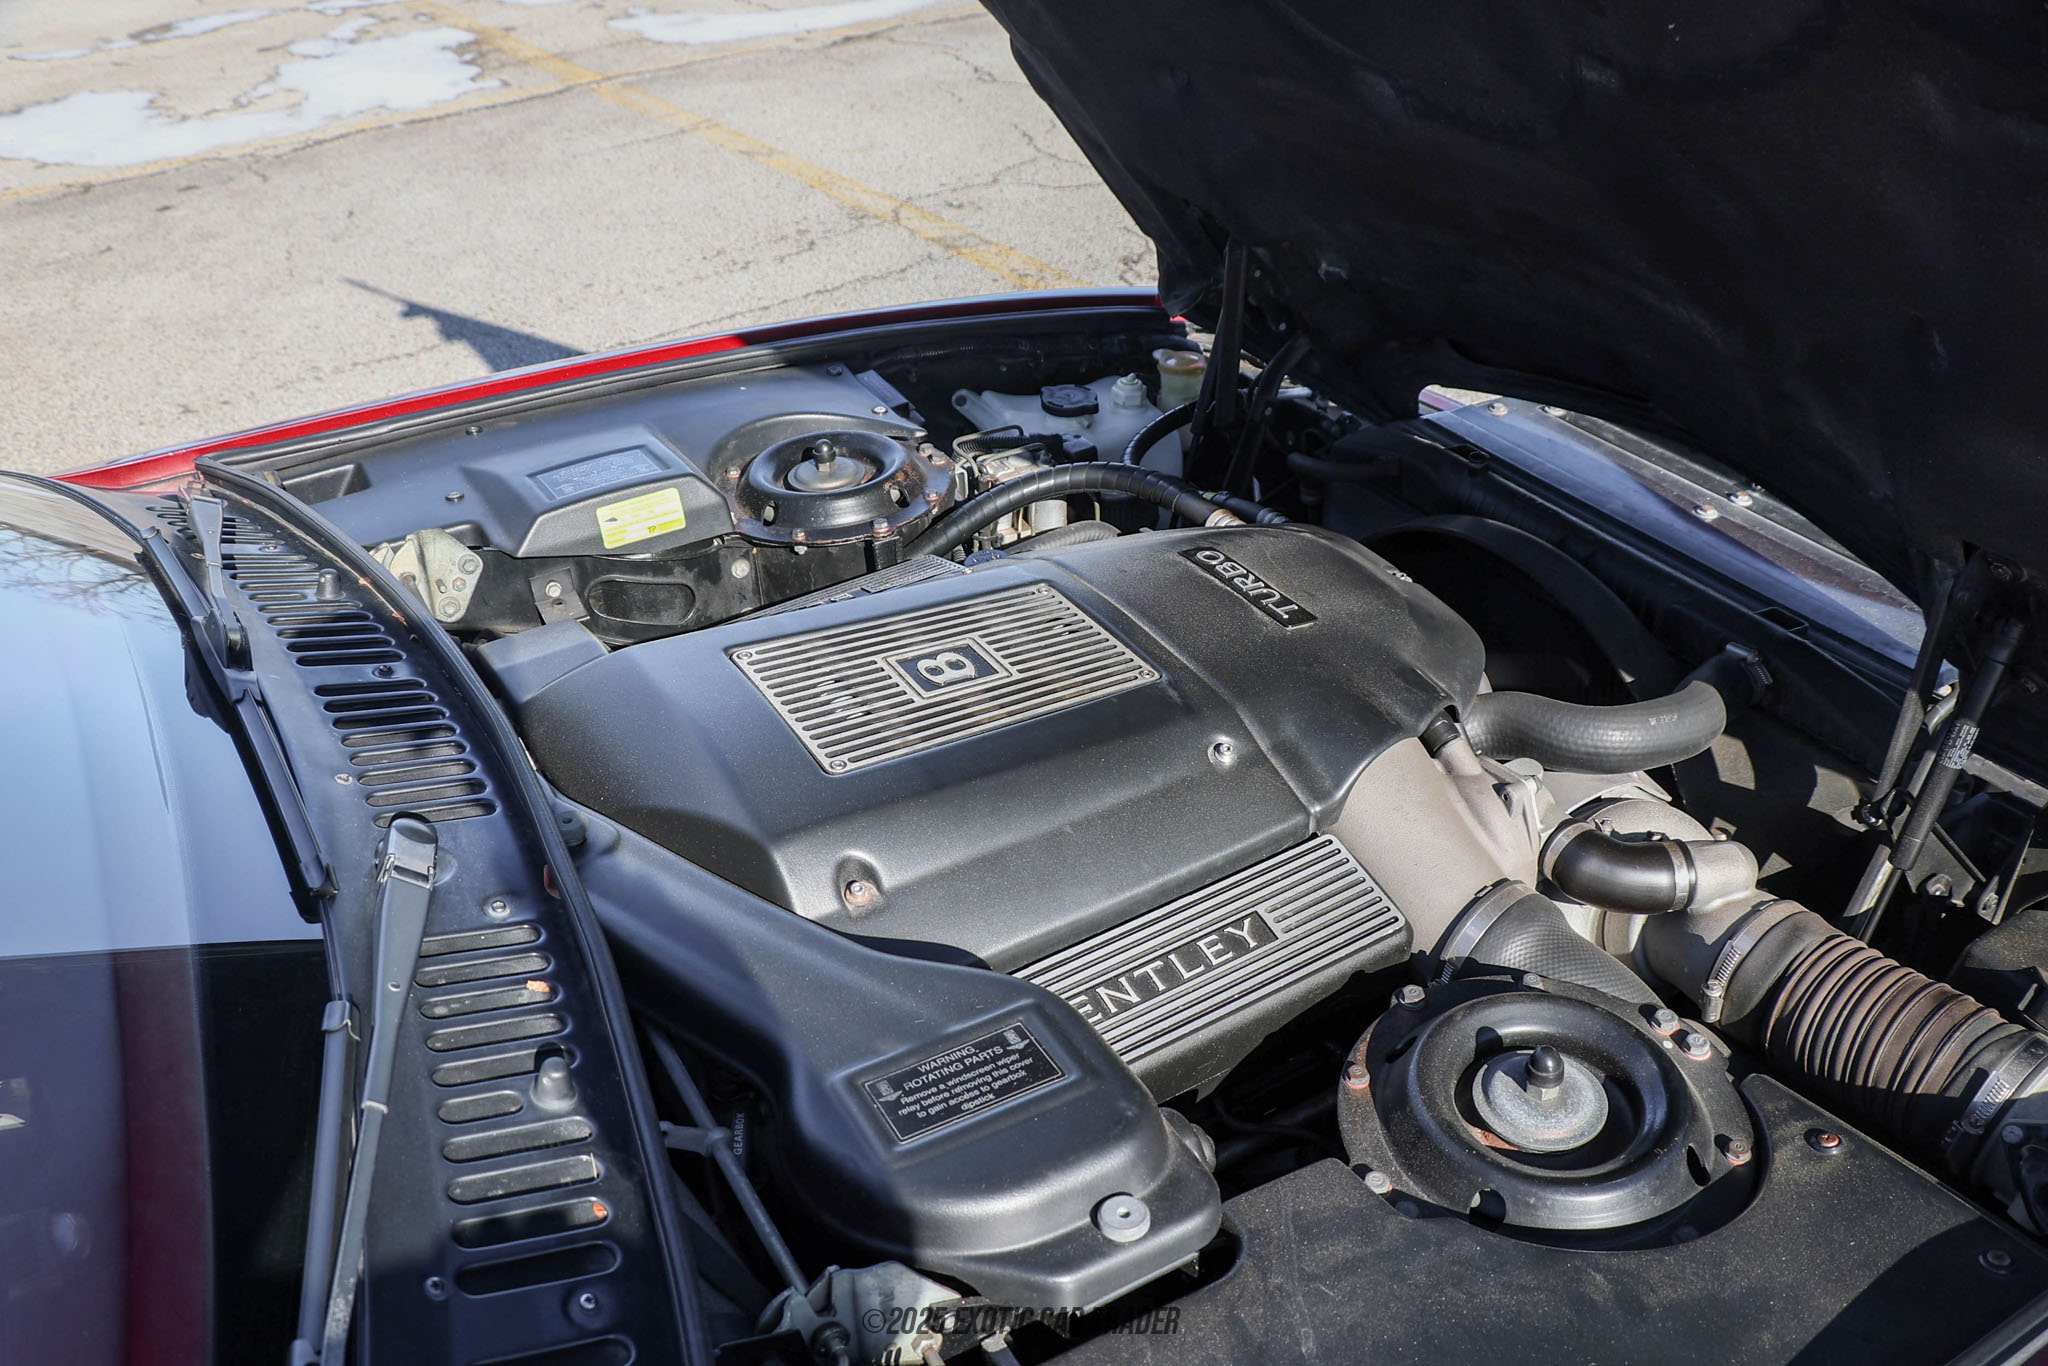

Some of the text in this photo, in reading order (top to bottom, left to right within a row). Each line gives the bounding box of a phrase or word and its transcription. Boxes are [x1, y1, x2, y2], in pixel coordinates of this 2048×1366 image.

[1195, 550, 1299, 619] TURBO
[1068, 917, 1257, 1023] ENTLEY
[898, 1056, 1034, 1117] relay before removing this cover
[900, 1084, 938, 1105] Remove
[938, 1083, 946, 1091] a
[946, 1063, 996, 1087] windscreen
[996, 1053, 1020, 1068] wiper
[903, 1062, 964, 1091] ROTATING
[963, 1046, 1004, 1067] PARTS
[916, 1068, 1028, 1119] to gain access to gearbox
[960, 1092, 996, 1111] dipstick
[733, 1112, 745, 1156] GEARBOX
